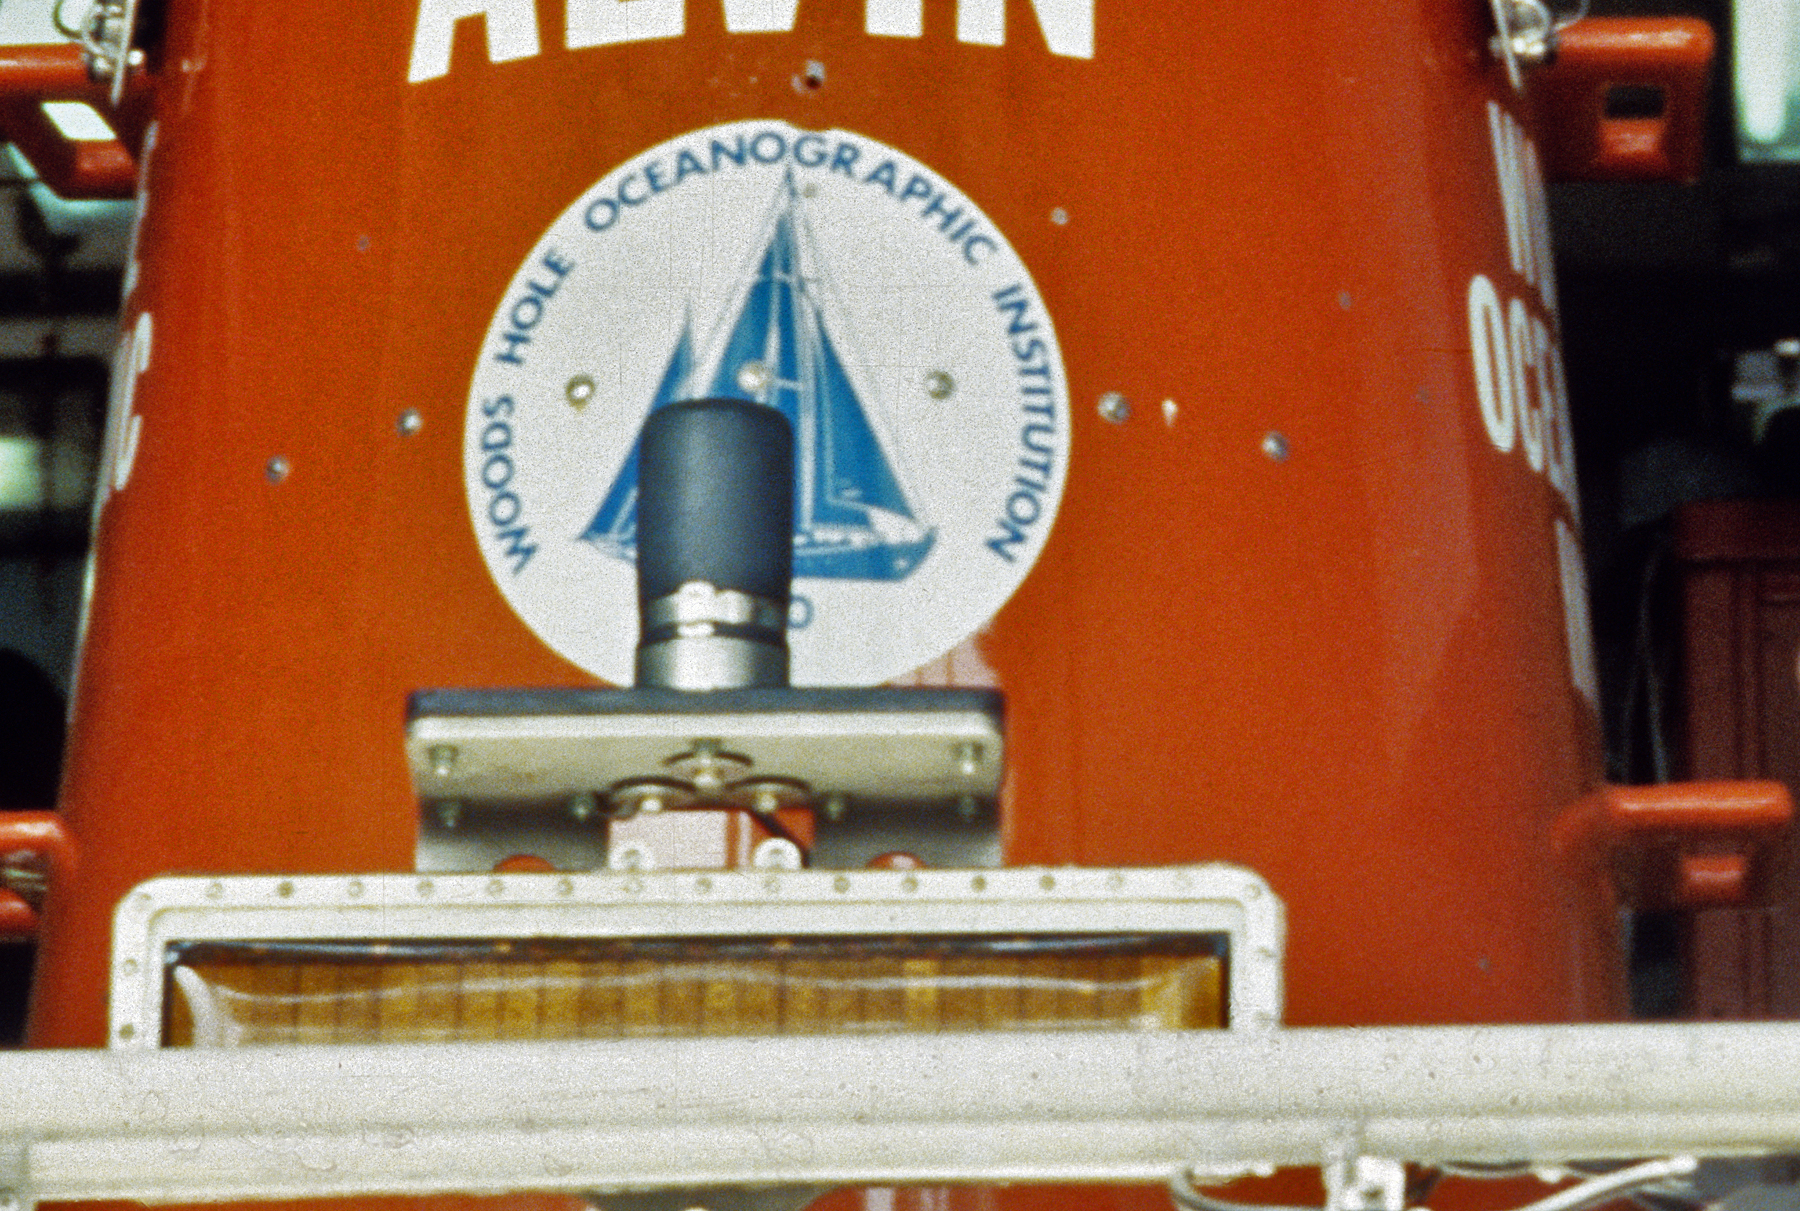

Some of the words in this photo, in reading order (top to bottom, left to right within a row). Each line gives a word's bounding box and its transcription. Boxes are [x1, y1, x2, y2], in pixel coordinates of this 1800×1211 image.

[583, 131, 999, 267] OCEANOGRAPHIC
[494, 246, 576, 367] HOLE
[480, 393, 538, 577] WOODS
[985, 282, 1057, 564] INSTITUTION
